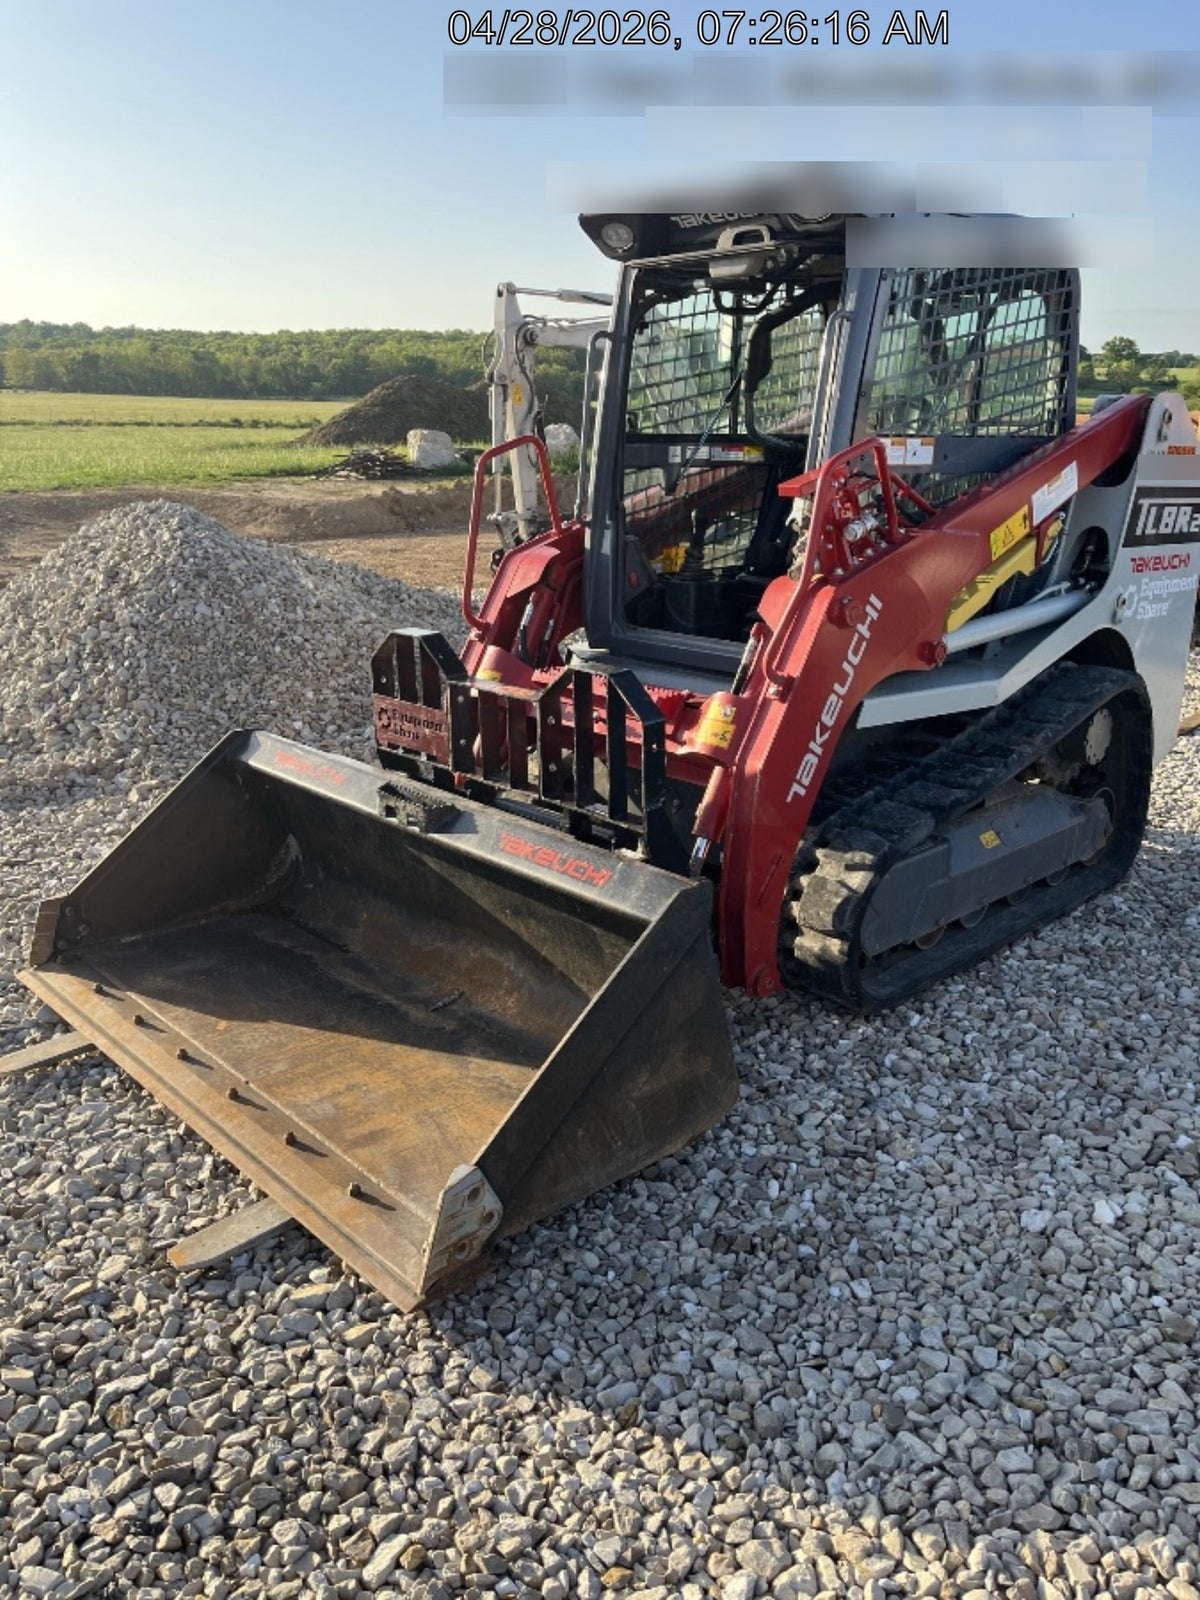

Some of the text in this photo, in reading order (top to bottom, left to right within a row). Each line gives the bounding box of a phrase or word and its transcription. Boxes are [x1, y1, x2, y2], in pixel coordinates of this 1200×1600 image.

[1130, 553, 1191, 573] TAKEUCHI
[1136, 600, 1169, 619] Share
[786, 593, 884, 803] TAKEUCHI
[501, 833, 612, 888] TAKEUCHI
